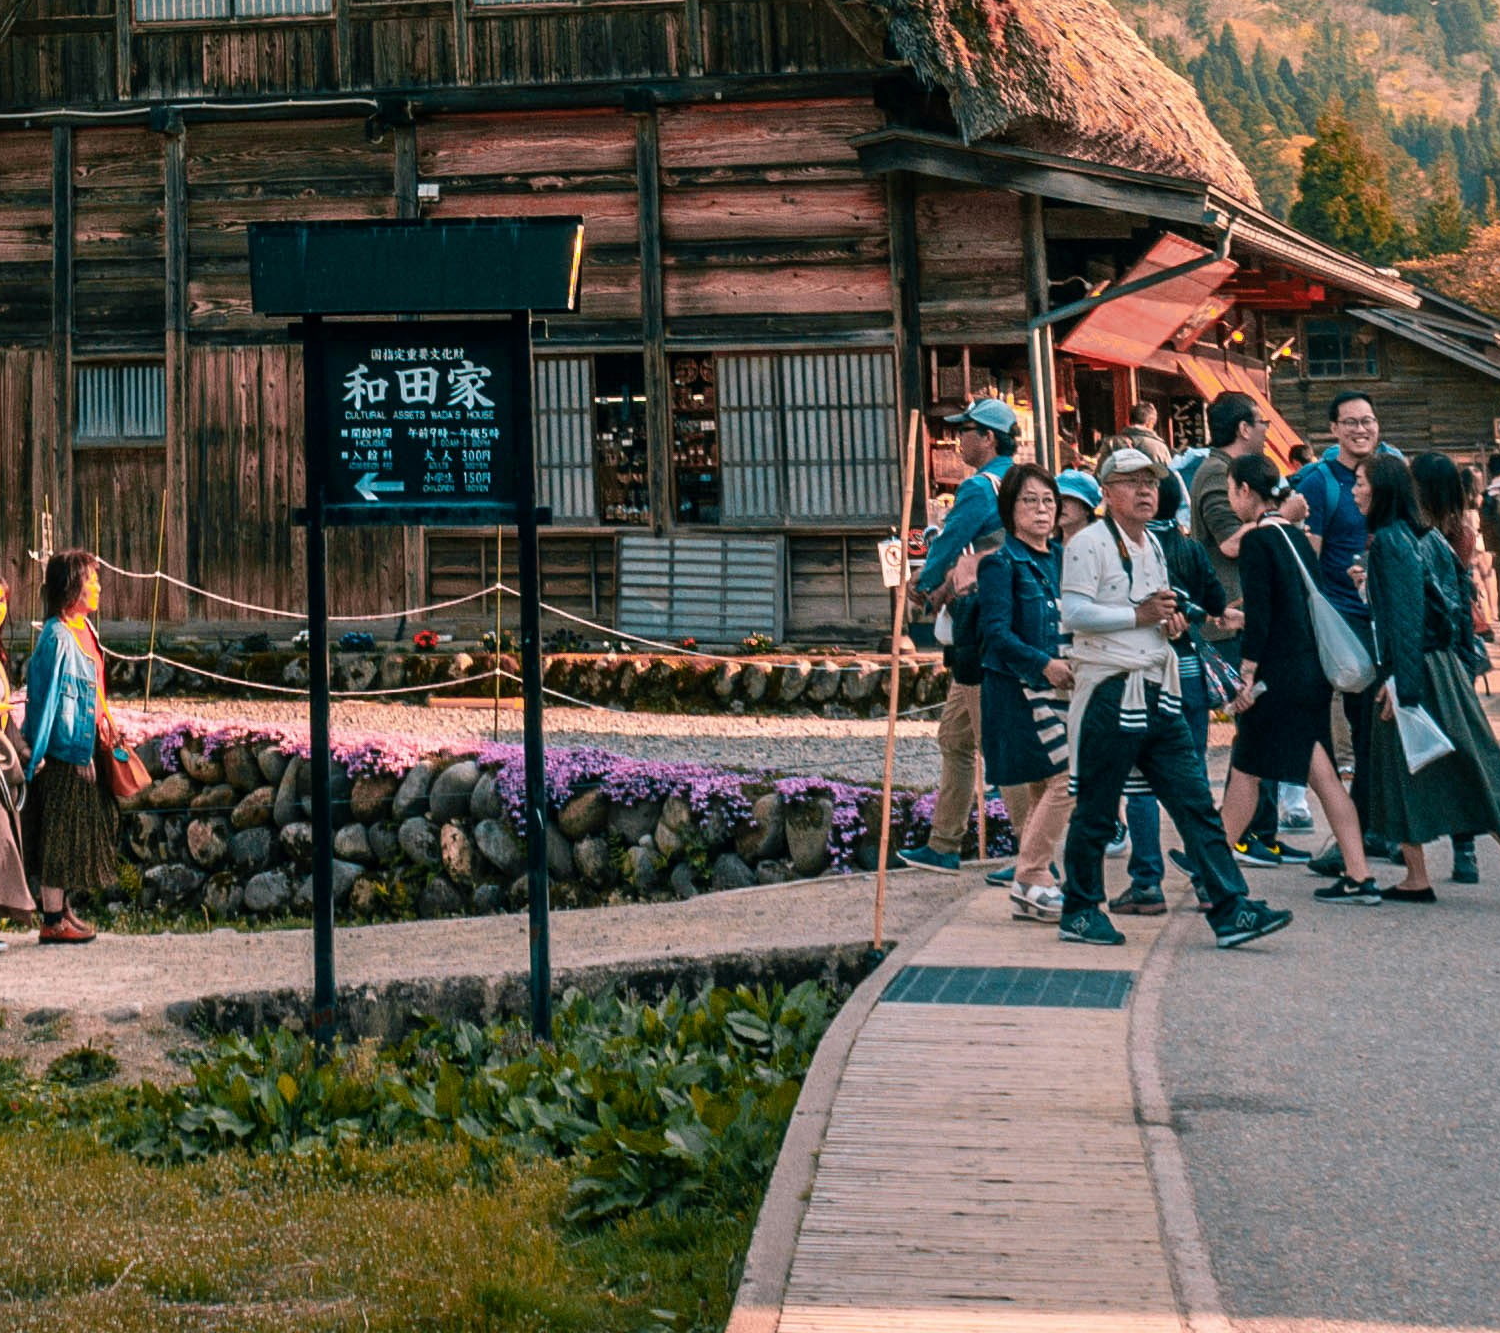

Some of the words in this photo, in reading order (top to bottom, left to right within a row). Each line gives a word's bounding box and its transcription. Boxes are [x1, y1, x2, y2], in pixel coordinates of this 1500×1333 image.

[370, 348, 465, 361] 国指定重要文化財
[342, 360, 495, 410] 和田家
[345, 410, 386, 420] CULTURAL
[393, 410, 425, 420] ASSETS
[466, 410, 494, 420] HOUSE
[462, 449, 491, 461] 300円
[463, 471, 491, 484] 150円
